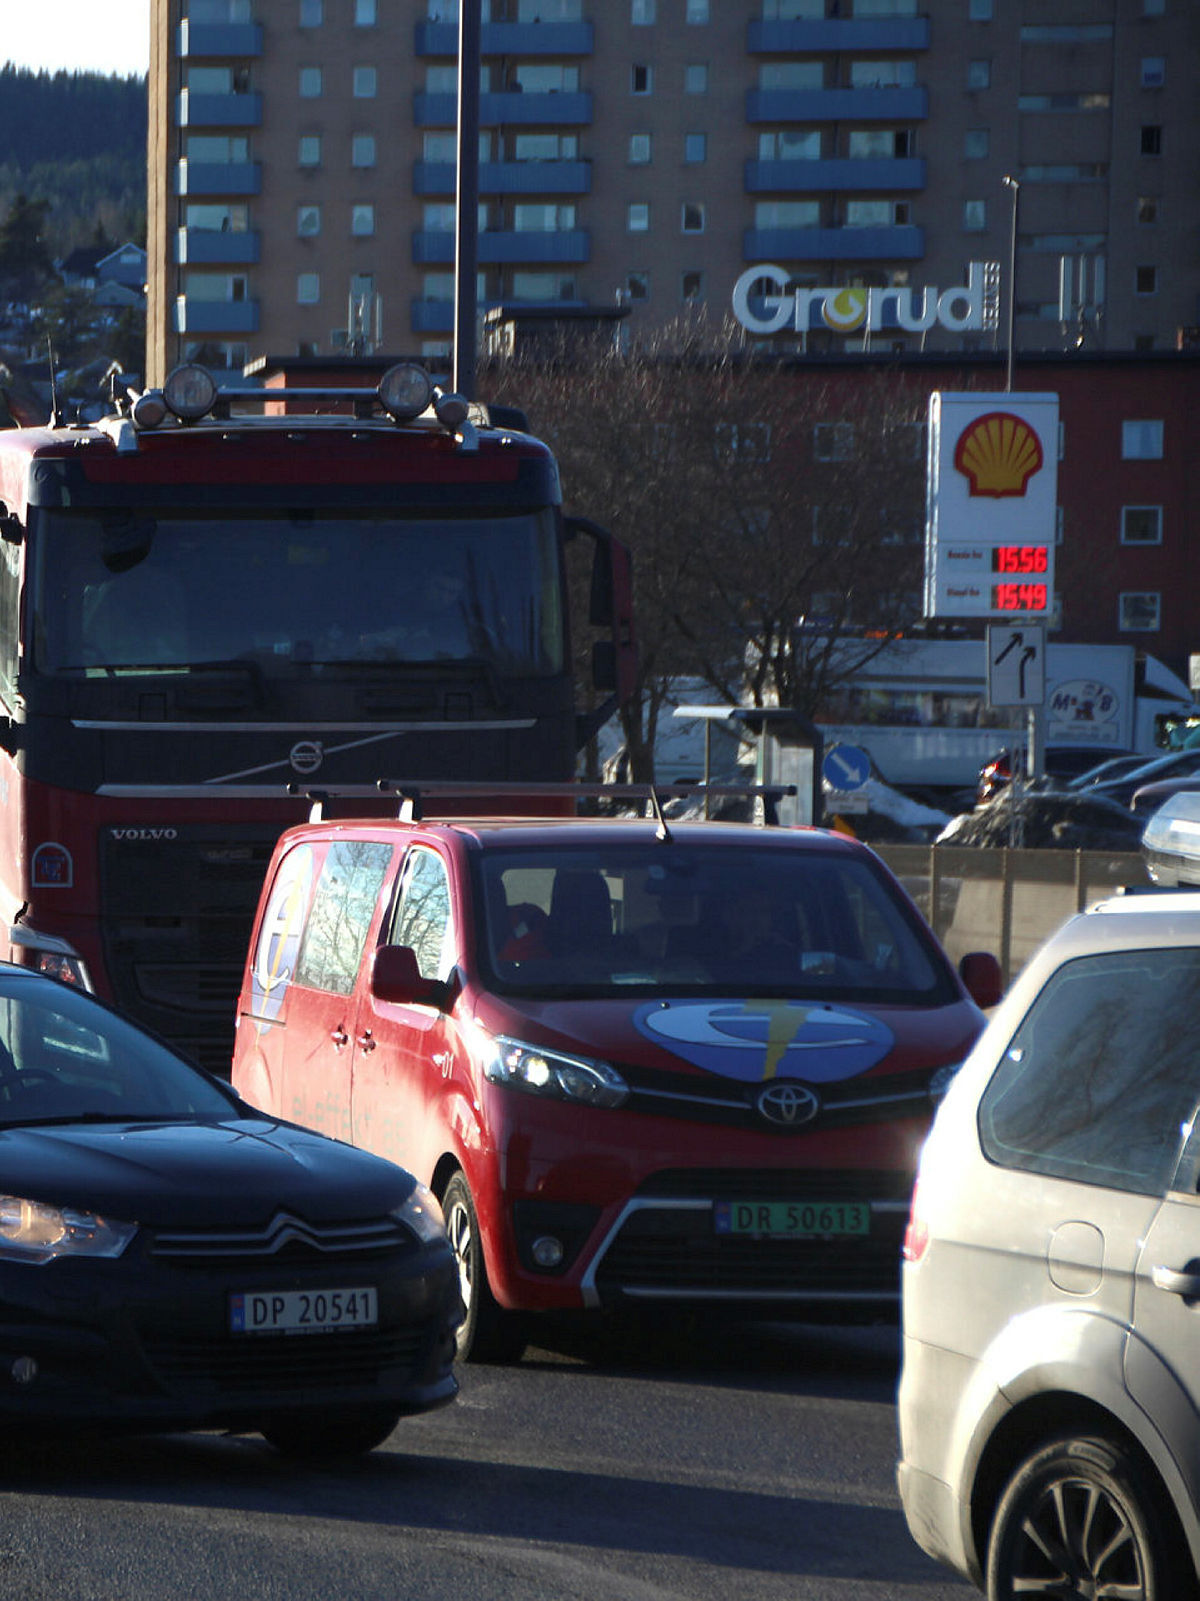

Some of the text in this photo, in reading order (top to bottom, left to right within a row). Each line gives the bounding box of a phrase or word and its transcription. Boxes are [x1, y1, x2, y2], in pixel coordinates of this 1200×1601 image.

[732, 261, 984, 334] Grorud
[111, 828, 178, 840] VOLVO
[737, 1206, 862, 1231] DR 50613
[252, 1293, 369, 1325] DP 20541
